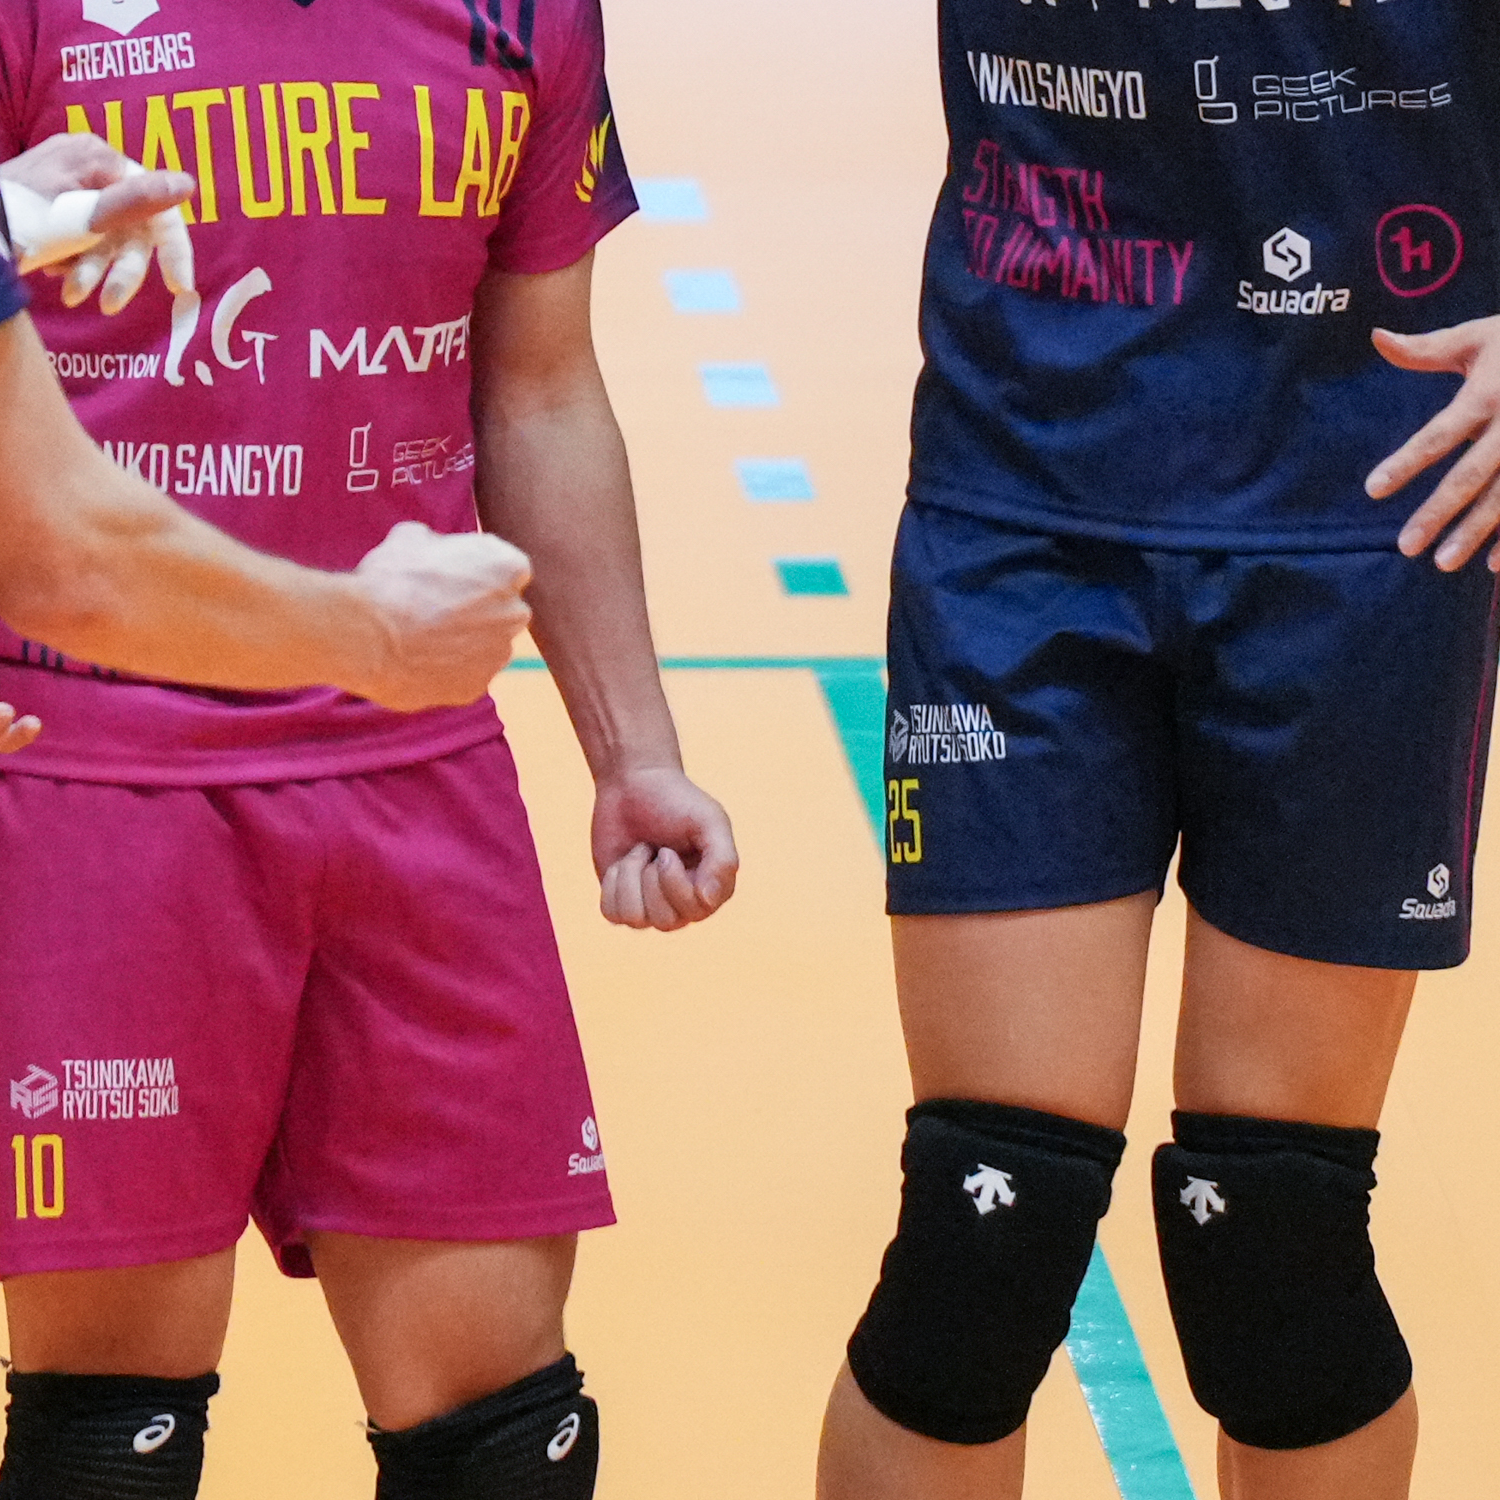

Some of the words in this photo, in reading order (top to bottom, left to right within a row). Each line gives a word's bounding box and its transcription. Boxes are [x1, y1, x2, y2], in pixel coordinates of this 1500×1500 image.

[60, 32, 195, 82] GREATBEARS
[1252, 67, 1357, 96] GEEK
[1254, 82, 1452, 122] PICTURES
[412, 84, 531, 218] LAB
[1237, 279, 1351, 315] Squadra
[103, 440, 170, 496] NKO
[174, 443, 304, 496] SANGYO
[888, 778, 923, 865] 25
[61, 1057, 176, 1090] TSUNOKAWA
[63, 1089, 134, 1121] RYUTSU
[138, 1085, 180, 1119] SOKO
[11, 1133, 65, 1220] 10
